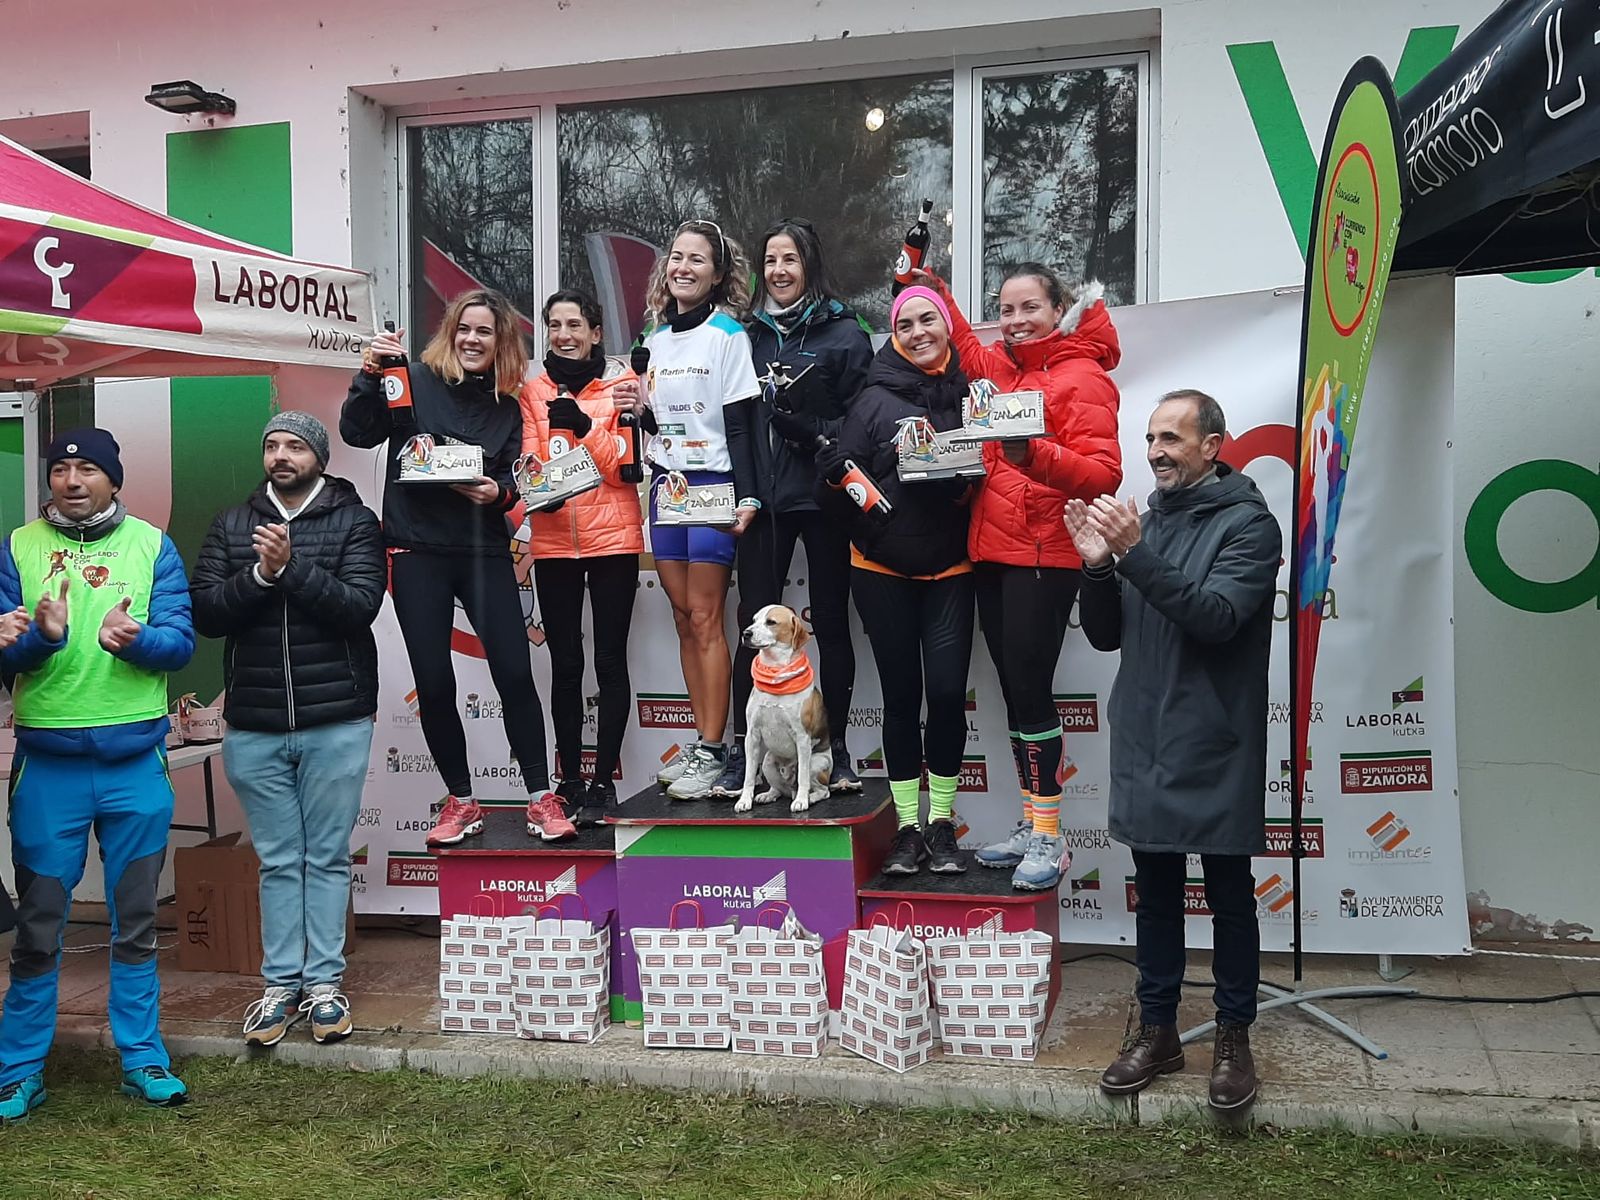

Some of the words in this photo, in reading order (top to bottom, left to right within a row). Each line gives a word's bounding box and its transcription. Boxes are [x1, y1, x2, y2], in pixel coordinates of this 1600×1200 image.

[212, 260, 357, 322] LABORAL
[307, 323, 363, 354] kutxa
[386, 379, 396, 396] 3
[553, 439, 563, 455] 3
[849, 487, 861, 502] 3
[481, 709, 495, 719] DE
[654, 712, 696, 723] ZAMOR
[1064, 715, 1094, 726] ORA
[1346, 712, 1425, 728] LABORAL
[1392, 727, 1425, 737] kutxa
[401, 762, 414, 773] DE
[474, 767, 523, 778] LABORA
[1026, 743, 1042, 796] alenji
[1362, 765, 1413, 775] DIPUTACIÓN
[508, 779, 524, 788] kut
[1362, 773, 1429, 787] ZAMORA
[396, 820, 437, 832] LABOR
[1062, 828, 1111, 838] TAMIENTO
[1348, 847, 1431, 861] implantes
[402, 863, 438, 871] DIPUTACIÓ
[402, 871, 438, 882] ZAMO
[480, 880, 544, 893] LABORAL
[683, 885, 751, 899] LABORAL
[517, 893, 544, 903] kutxa
[1060, 897, 1102, 910] ORAL
[1362, 895, 1444, 906] AYUNTAMIENTO
[723, 899, 752, 909] kutxa
[1073, 909, 1103, 920] kutxa
[1361, 905, 1379, 917] DE
[1382, 904, 1444, 917] ZAMORA
